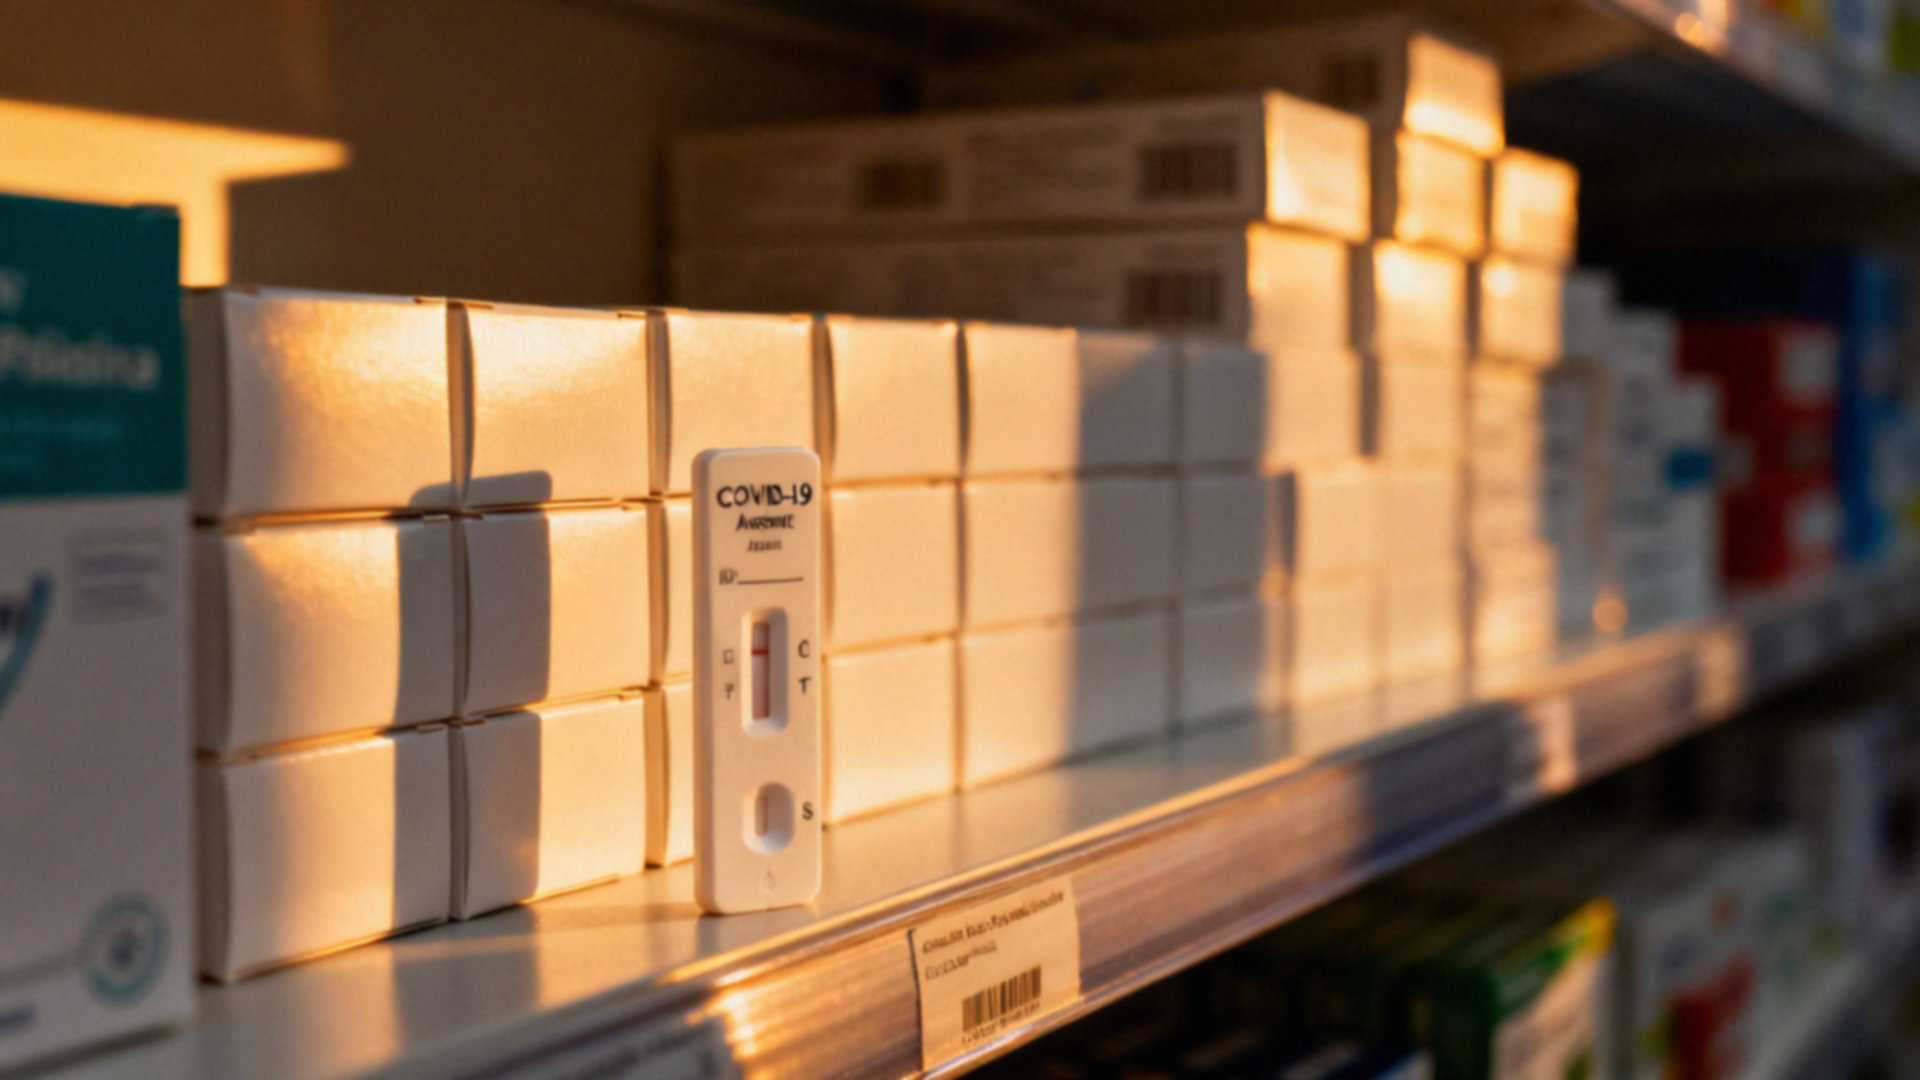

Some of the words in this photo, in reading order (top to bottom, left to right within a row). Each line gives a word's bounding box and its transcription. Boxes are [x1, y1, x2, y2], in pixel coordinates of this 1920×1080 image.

[716, 482, 813, 509] COVID-19
[798, 638, 810, 659] C
[798, 676, 812, 695] T
[801, 801, 814, 821] S
